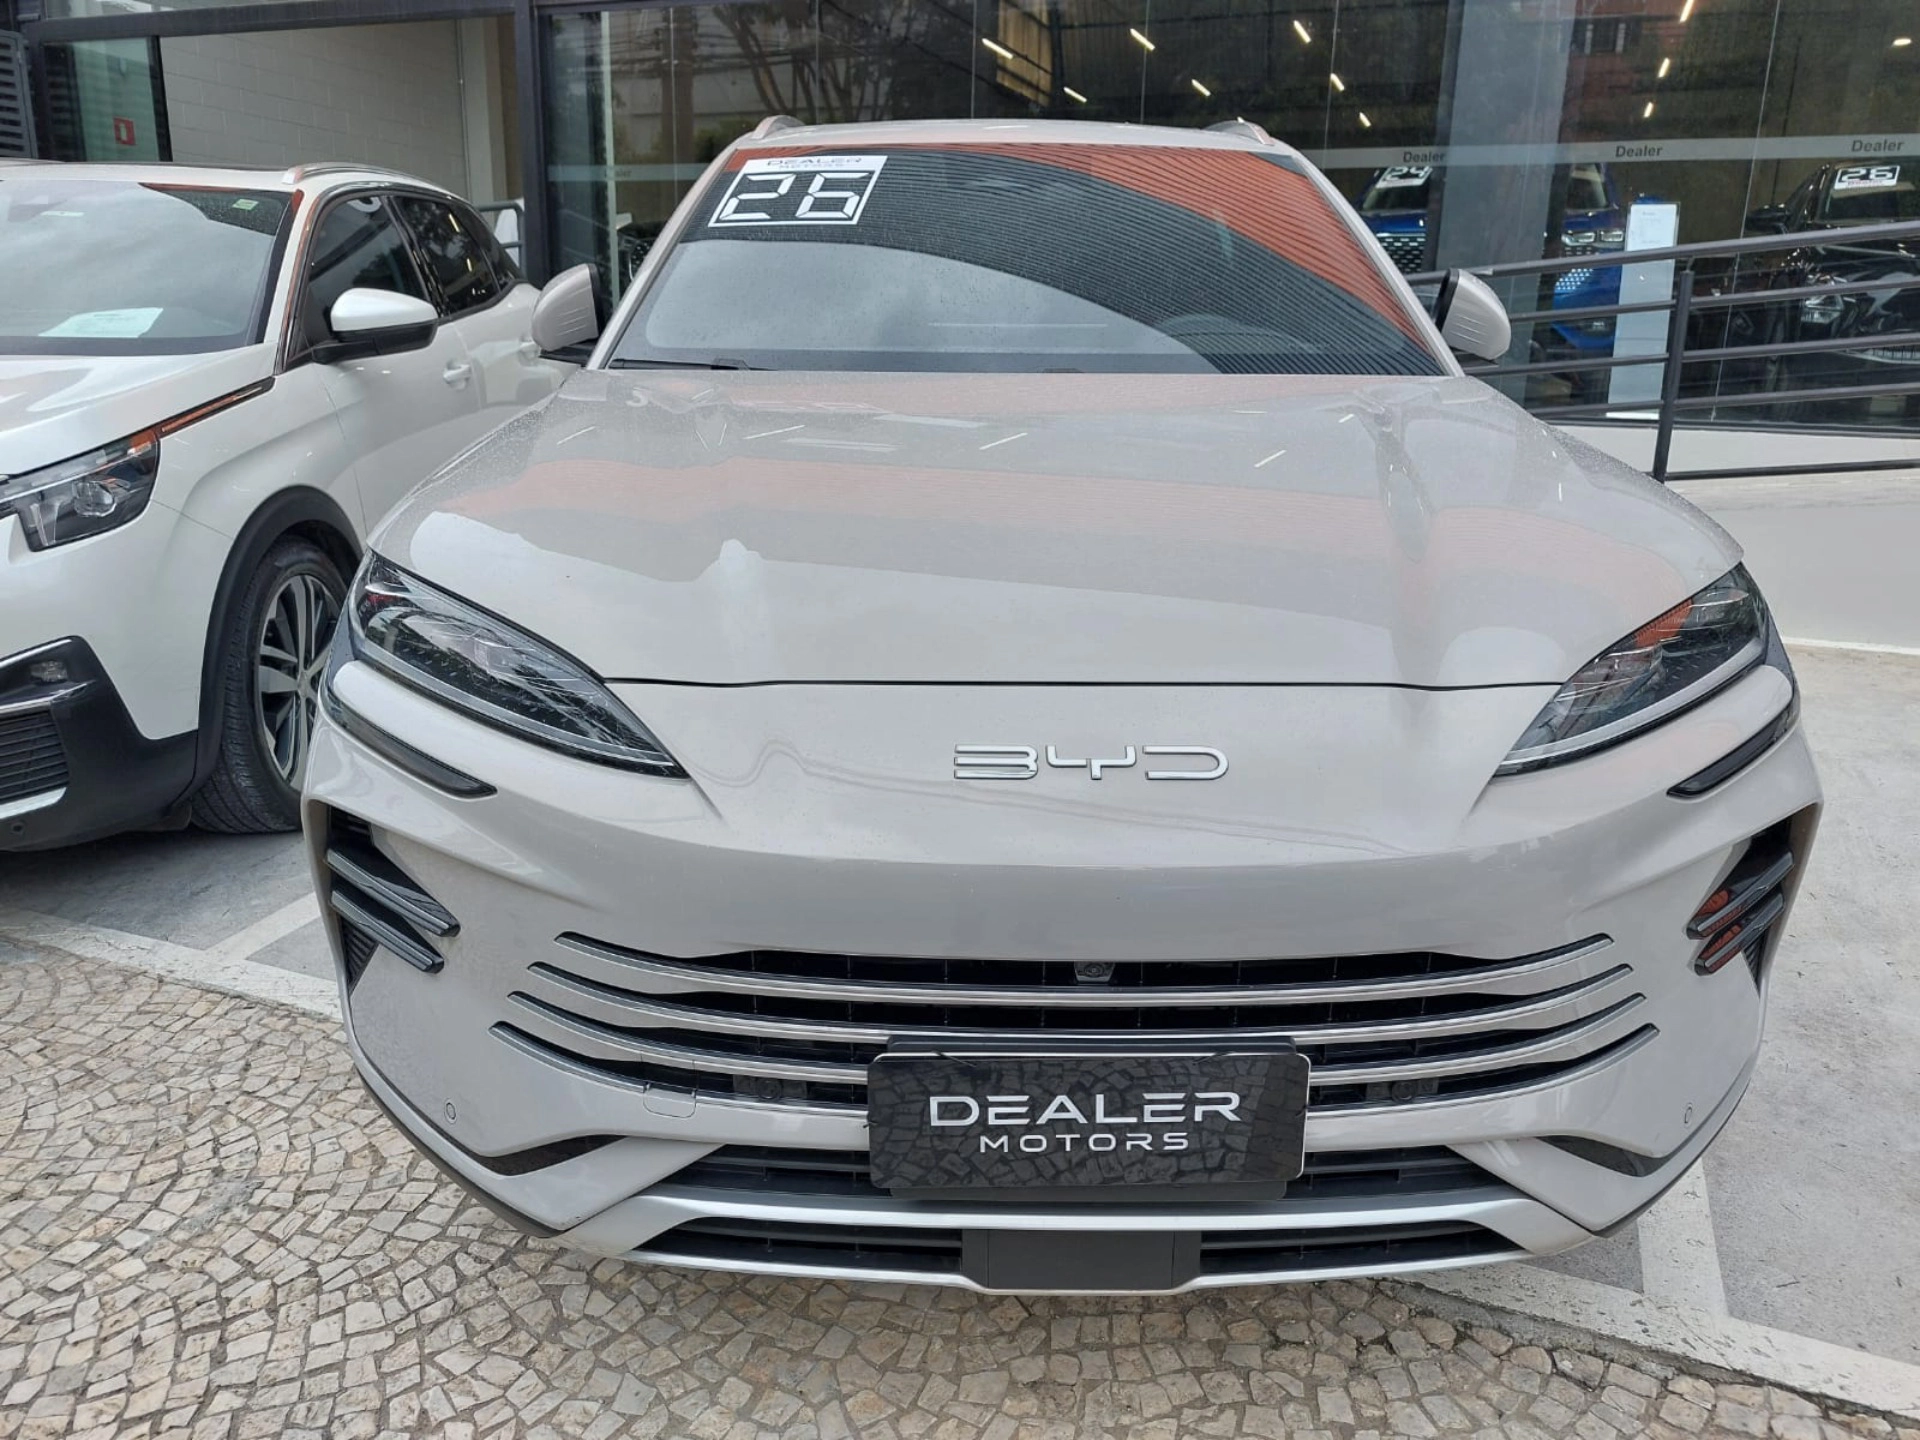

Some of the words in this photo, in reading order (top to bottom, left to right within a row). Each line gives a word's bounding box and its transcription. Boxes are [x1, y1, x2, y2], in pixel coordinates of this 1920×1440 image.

[1615, 144, 1663, 157] Dealer
[1851, 139, 1905, 152] Dealer
[1403, 151, 1446, 163] Dealer
[1841, 167, 1894, 181] 26
[719, 173, 870, 221] 26
[954, 745, 1229, 780] BYD
[929, 1091, 1242, 1127] DEALER
[979, 1132, 1189, 1153] MOTORS
